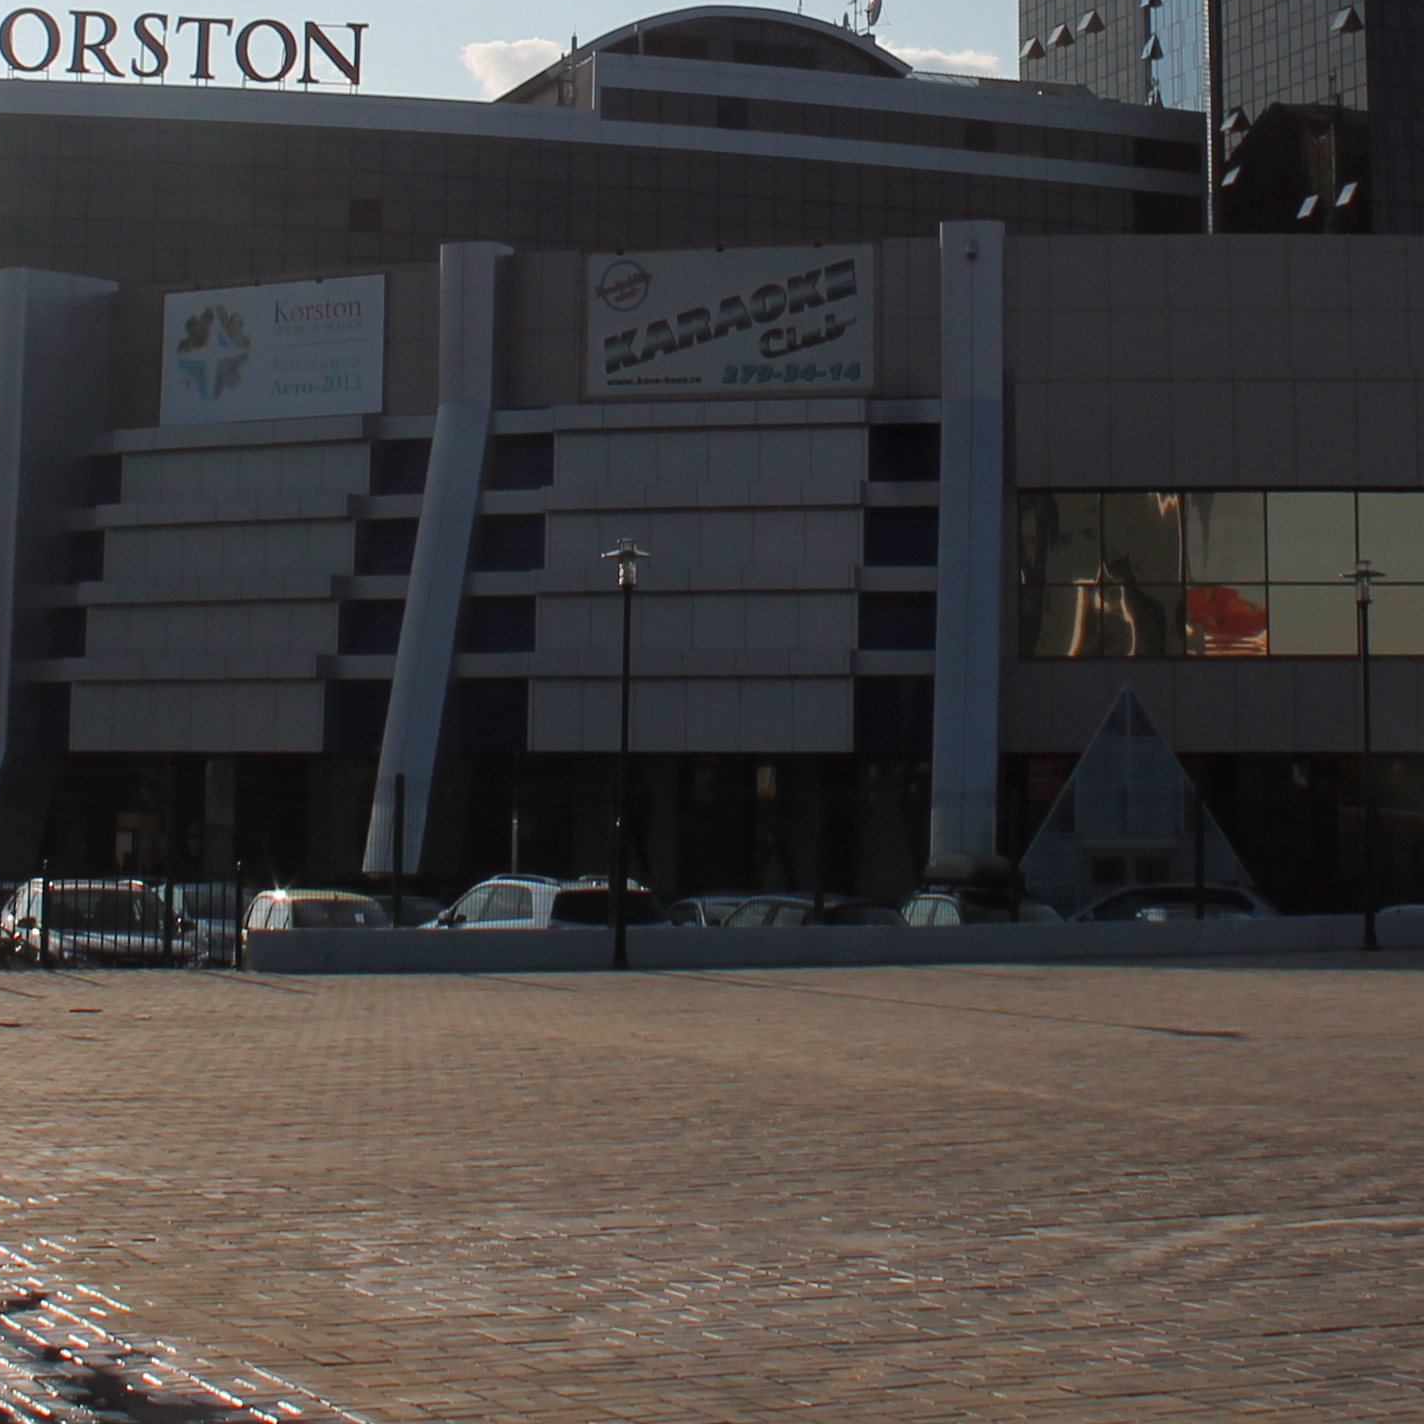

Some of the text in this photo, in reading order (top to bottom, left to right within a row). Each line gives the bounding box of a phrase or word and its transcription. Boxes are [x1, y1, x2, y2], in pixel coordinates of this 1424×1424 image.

[274, 299, 364, 324] Korston
[603, 258, 858, 375] KARAOKE
[269, 372, 363, 397] Лето-2013
[721, 361, 862, 385] 279-34-14
